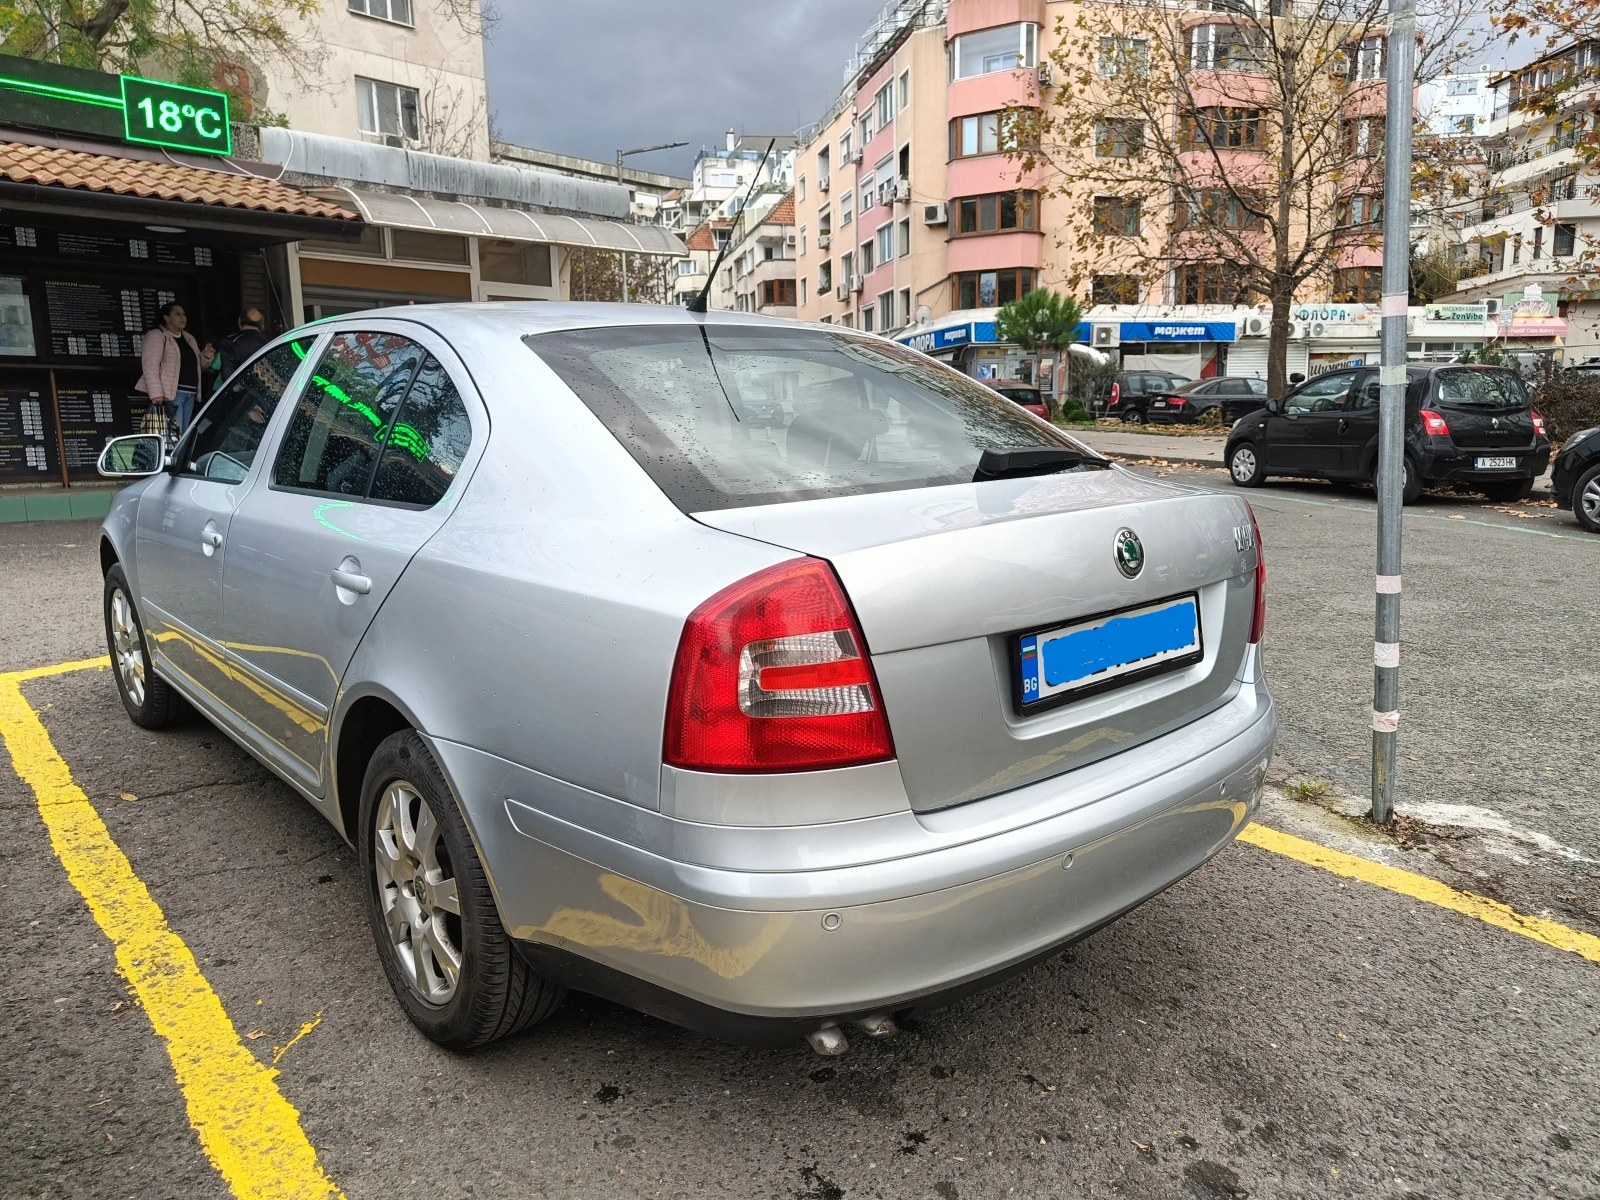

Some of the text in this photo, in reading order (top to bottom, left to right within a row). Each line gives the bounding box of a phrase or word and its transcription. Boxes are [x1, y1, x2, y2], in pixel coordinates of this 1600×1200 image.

[1298, 309, 1346, 321] ФЛОРА
[1451, 312, 1483, 320] ZenVibe
[944, 328, 967, 341] маркет
[1154, 326, 1205, 338] маркет
[1023, 676, 1037, 694] BG
